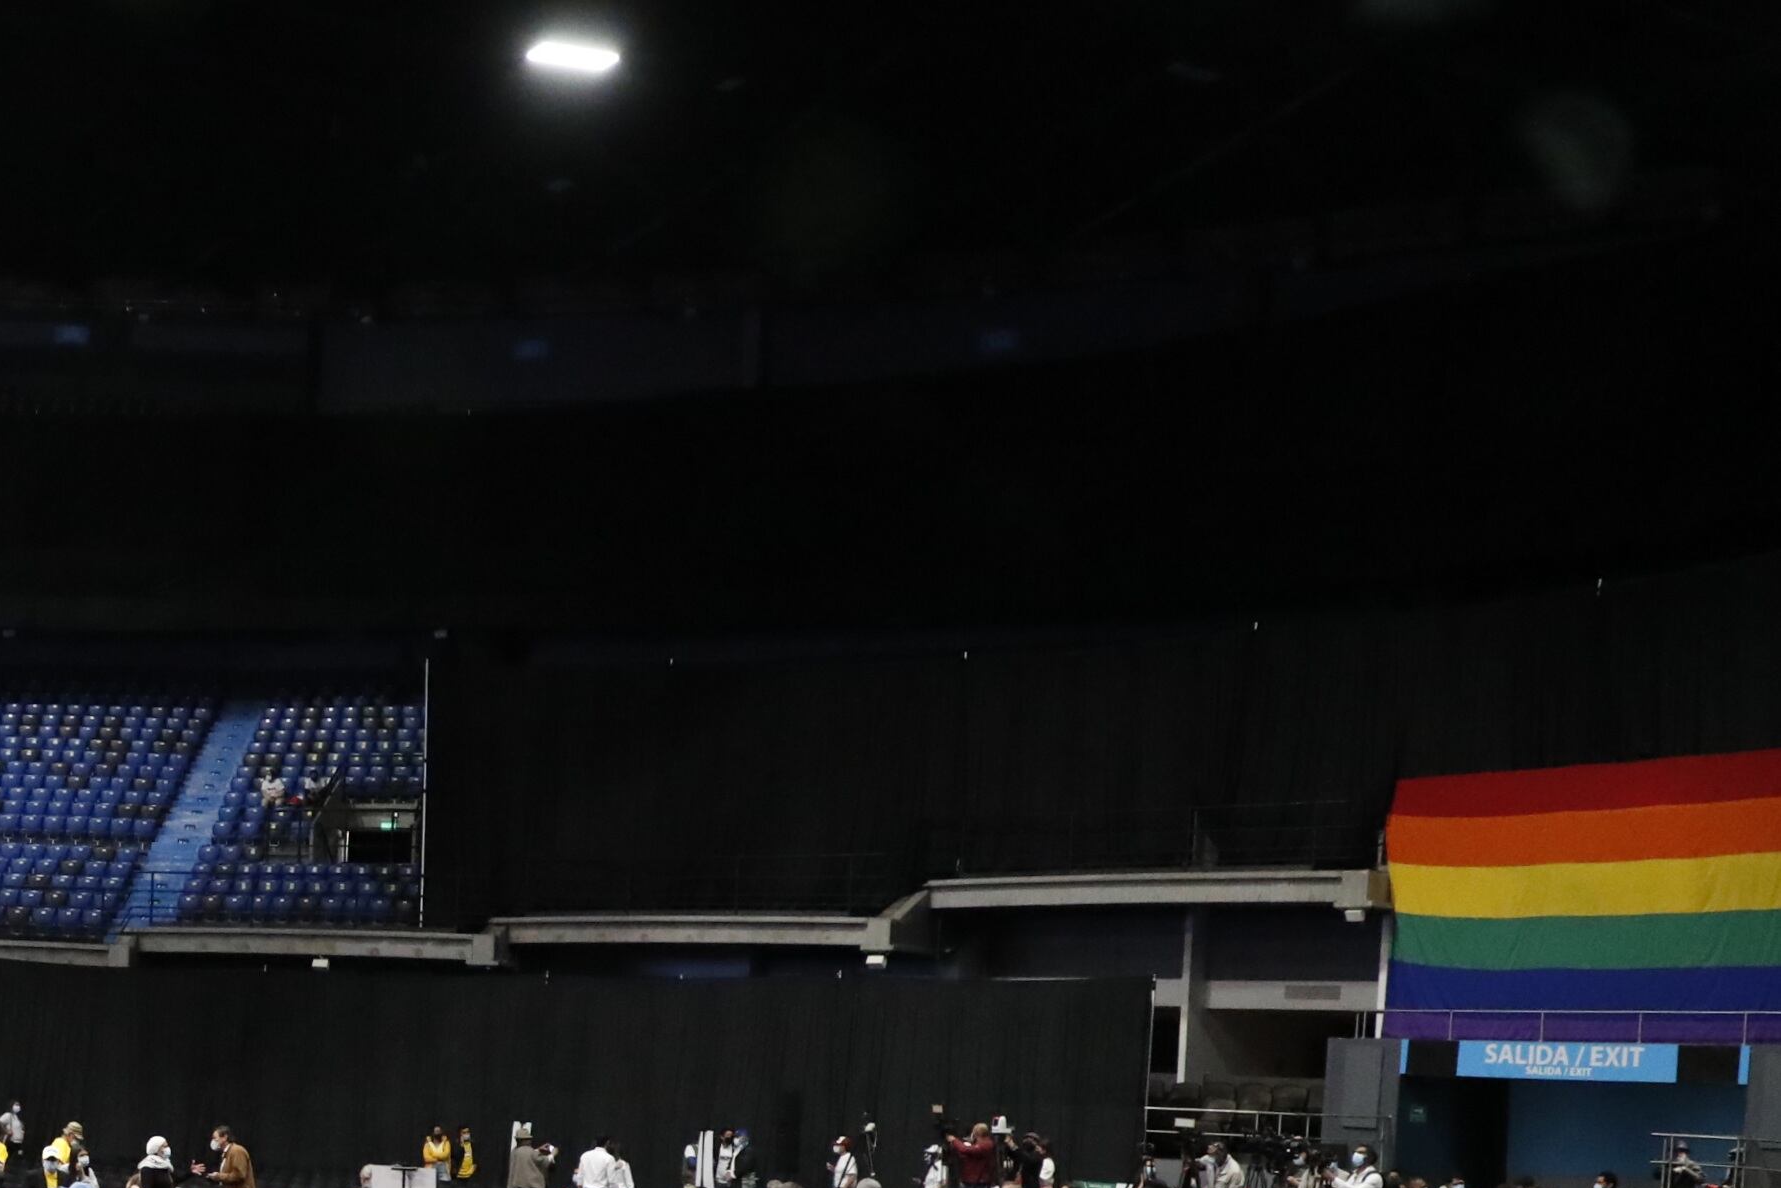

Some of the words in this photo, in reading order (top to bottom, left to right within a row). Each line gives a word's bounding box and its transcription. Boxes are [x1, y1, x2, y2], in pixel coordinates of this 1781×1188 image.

[1484, 1043, 1568, 1066] SALIDA
[1590, 1045, 1645, 1068] EXIT
[1525, 1065, 1562, 1076] SALIDA
[1570, 1067, 1592, 1077] EXIT
